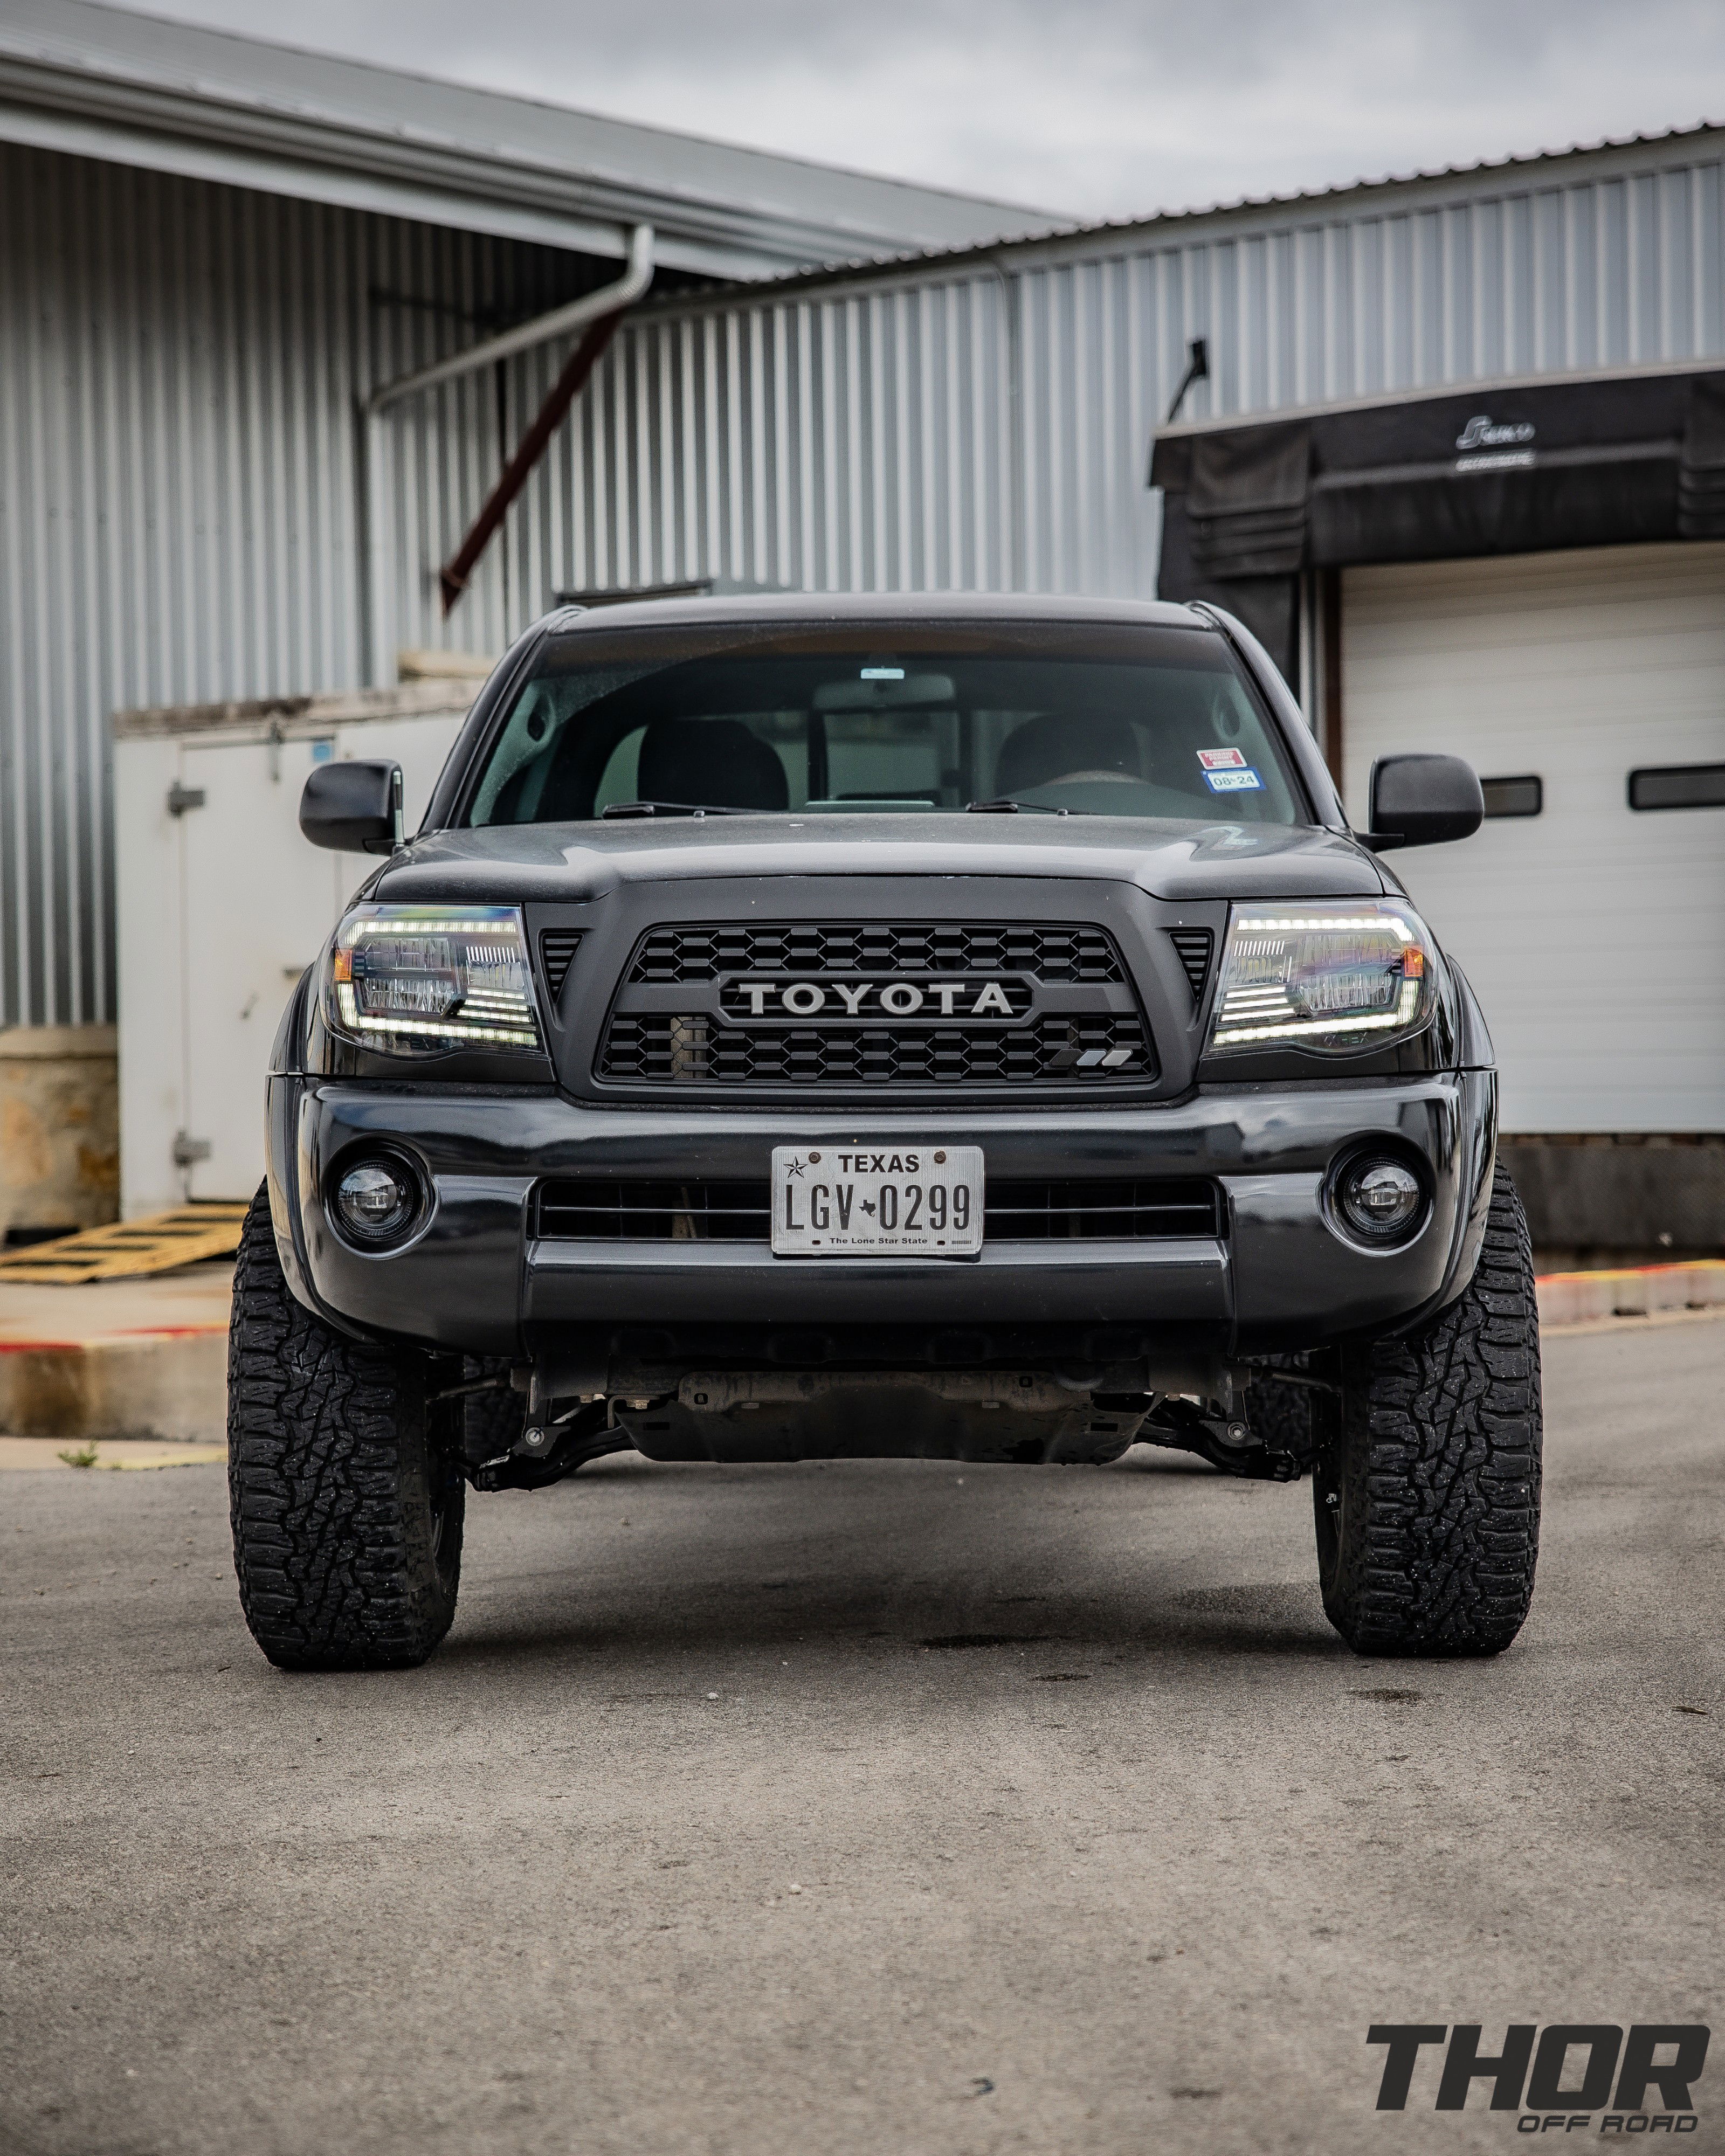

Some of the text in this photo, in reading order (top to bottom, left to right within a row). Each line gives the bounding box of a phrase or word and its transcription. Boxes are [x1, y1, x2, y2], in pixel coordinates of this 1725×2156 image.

[739, 983, 1014, 1015] TOYOTA
[838, 1154, 920, 1173] TEXAS
[785, 1184, 970, 1231] LGV 0299
